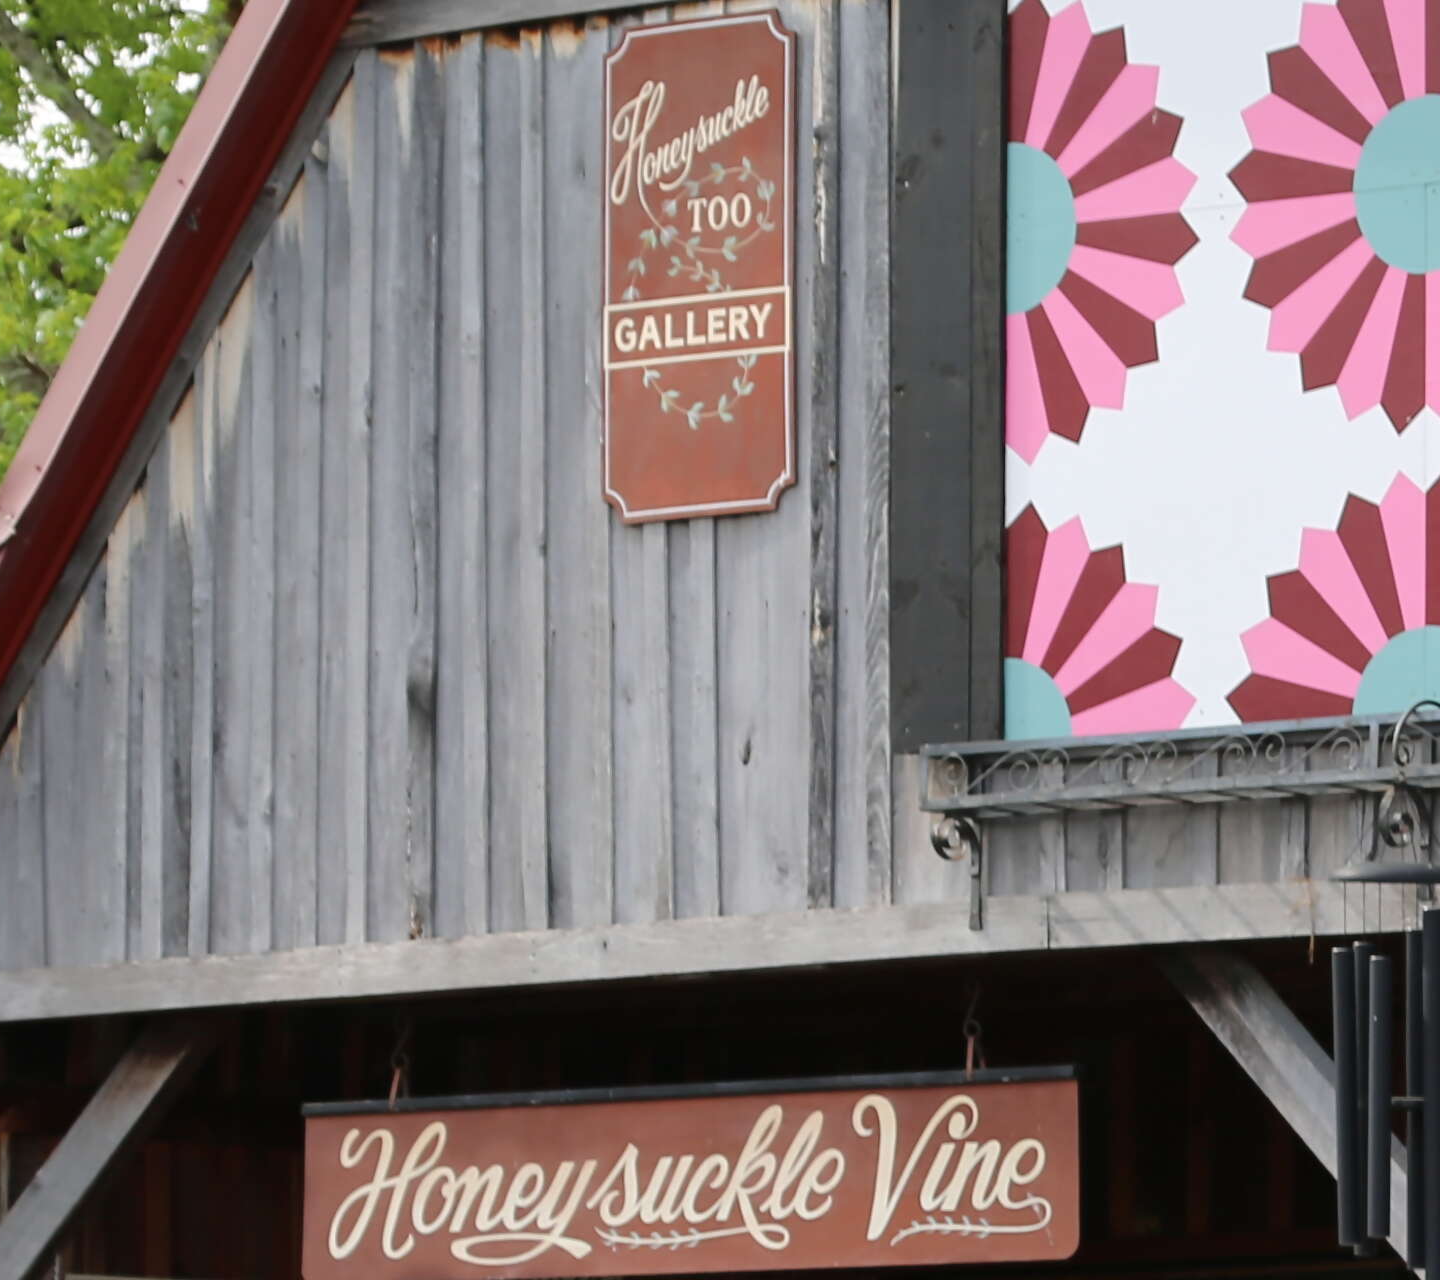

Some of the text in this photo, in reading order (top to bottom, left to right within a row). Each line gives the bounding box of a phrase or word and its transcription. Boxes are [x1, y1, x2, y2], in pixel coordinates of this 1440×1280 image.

[610, 73, 770, 205] Honeysuckle
[687, 192, 753, 233] TOO
[613, 302, 774, 354] GALLERY
[328, 1091, 1054, 1266] Honeysuckle Vine
